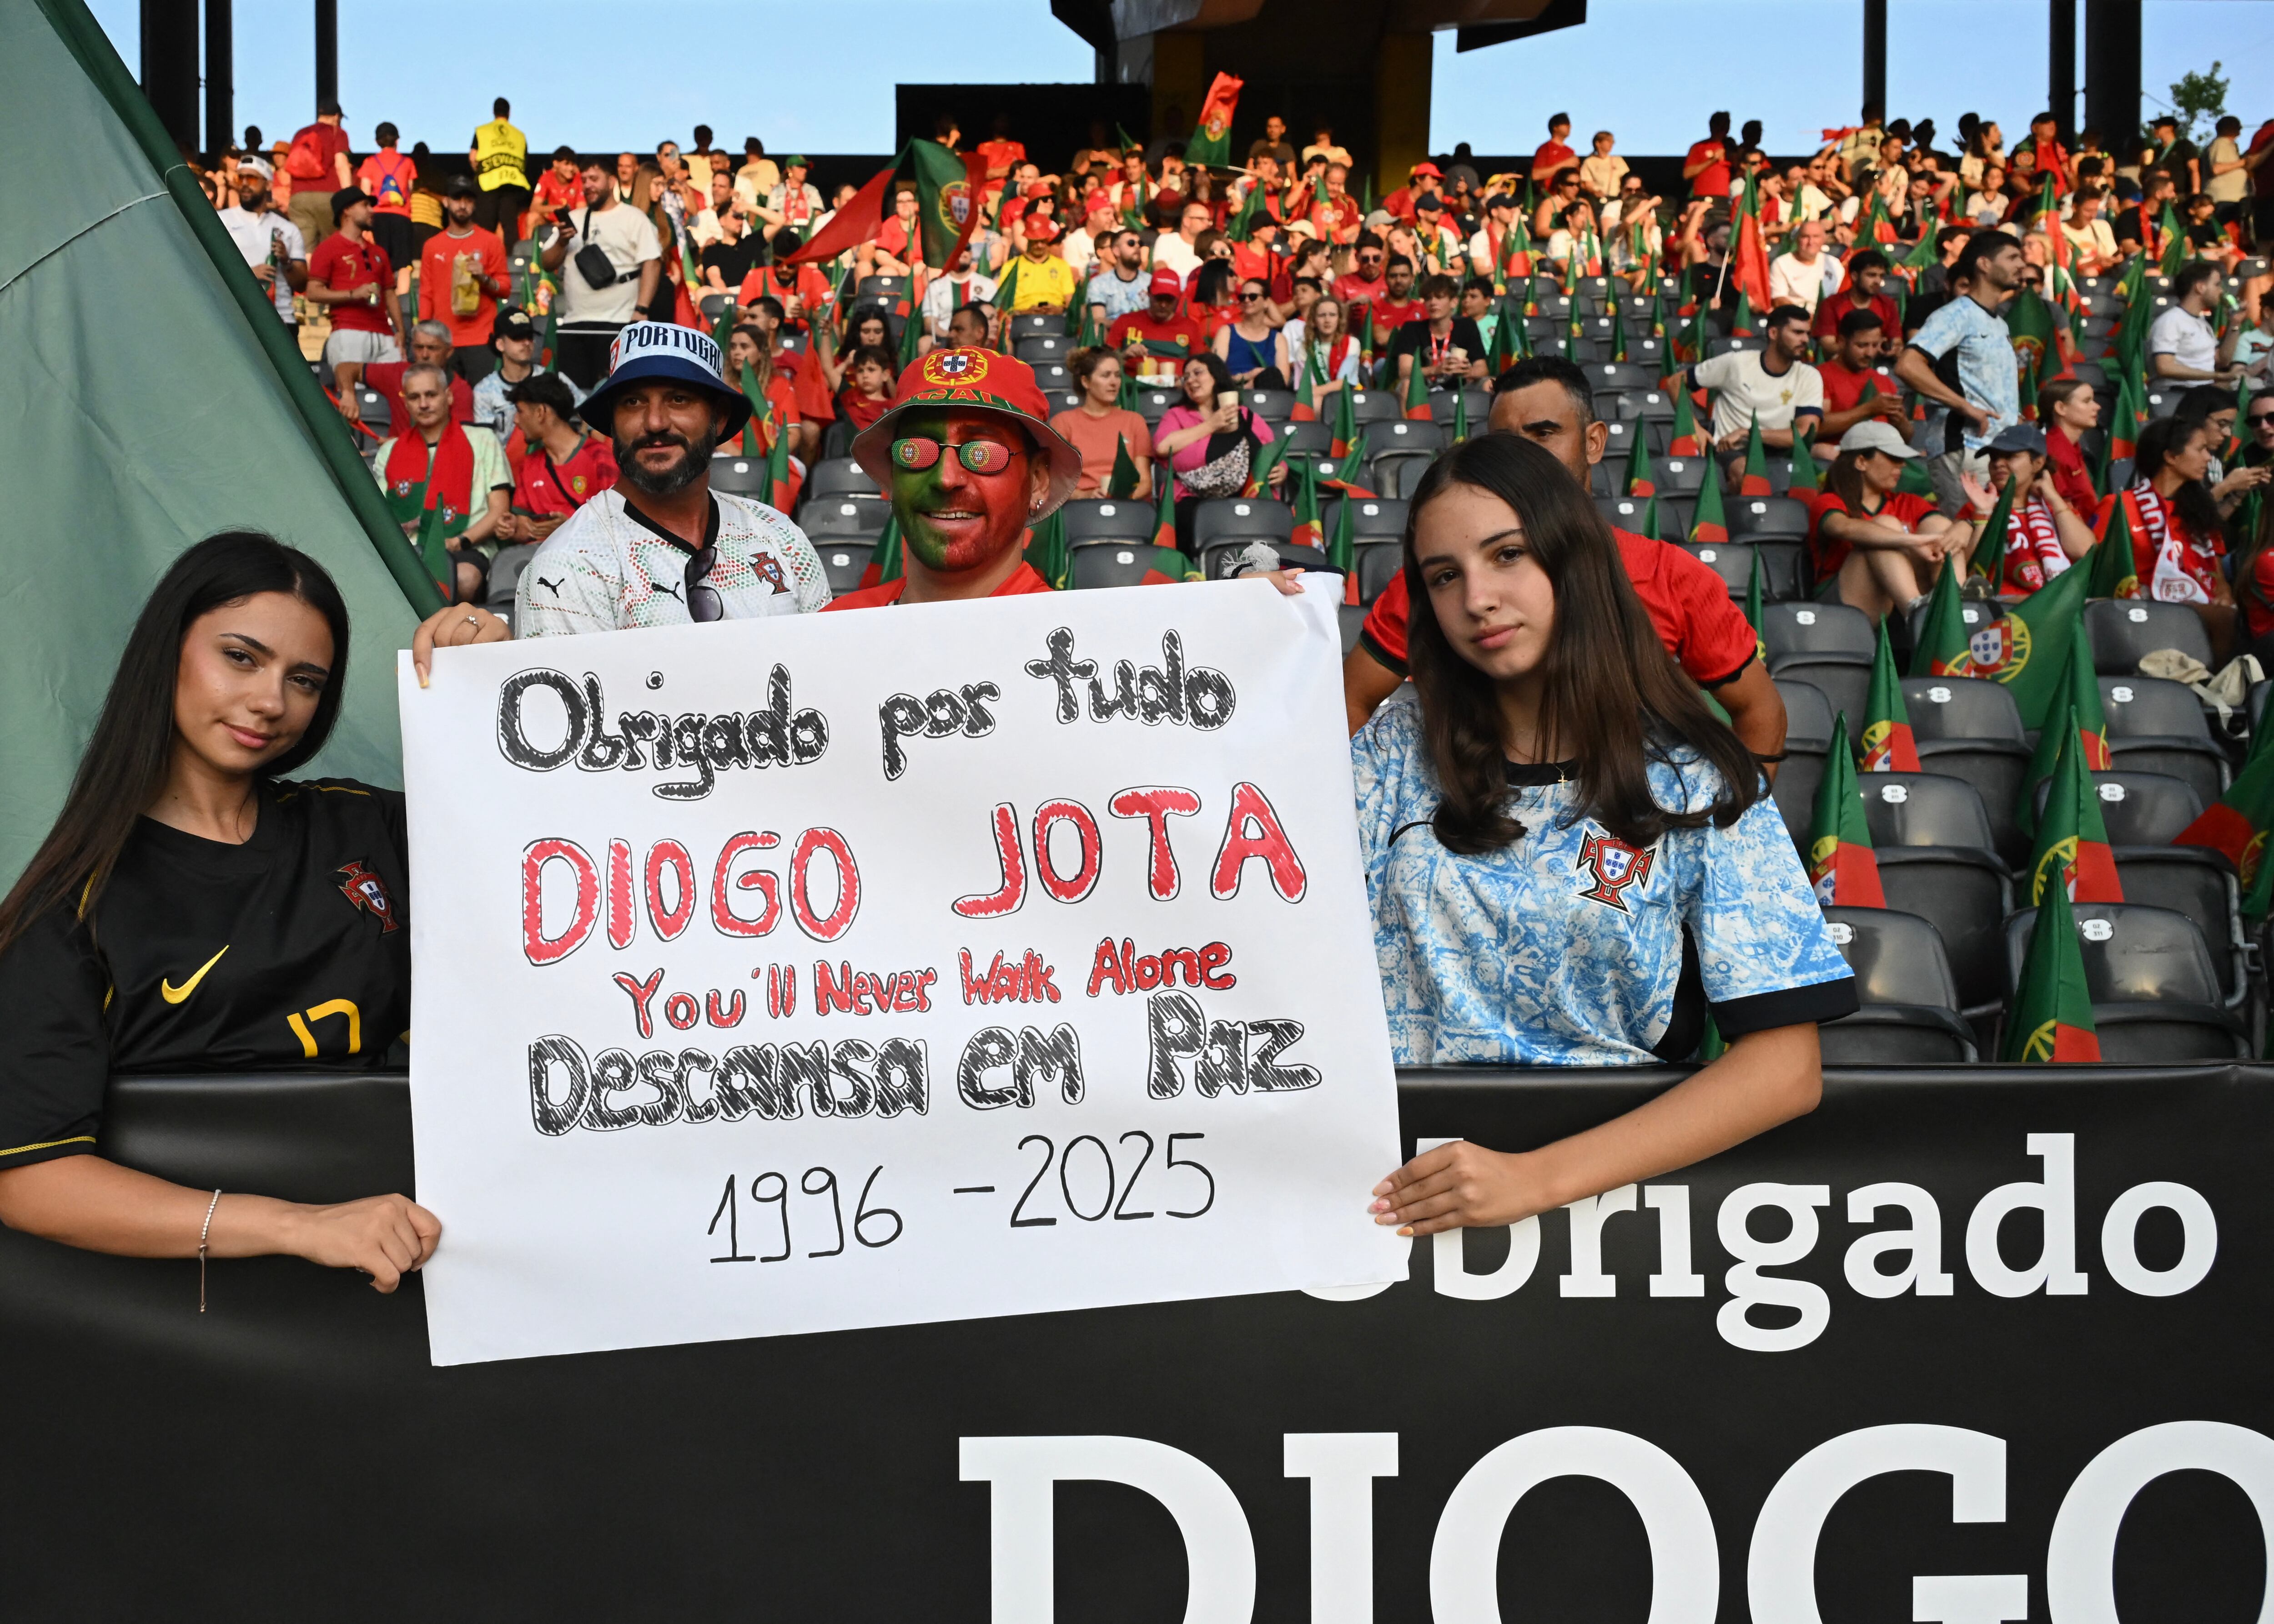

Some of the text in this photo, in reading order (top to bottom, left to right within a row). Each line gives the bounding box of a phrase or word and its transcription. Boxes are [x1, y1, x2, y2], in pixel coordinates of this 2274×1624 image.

[625, 325, 722, 379] PORTUGAL
[1127, 326, 1143, 345] 14
[497, 626, 1235, 800] Obrigado por tudo
[523, 782, 1307, 966] DIOGO JOTA
[287, 999, 361, 1059] 17
[613, 937, 1236, 1039] You'll Never Walk Alone
[528, 1034, 930, 1136] Descansa
[1147, 989, 1322, 1100] Paz
[707, 1165, 903, 1263] 1996
[1300, 1133, 2218, 1352] brigado
